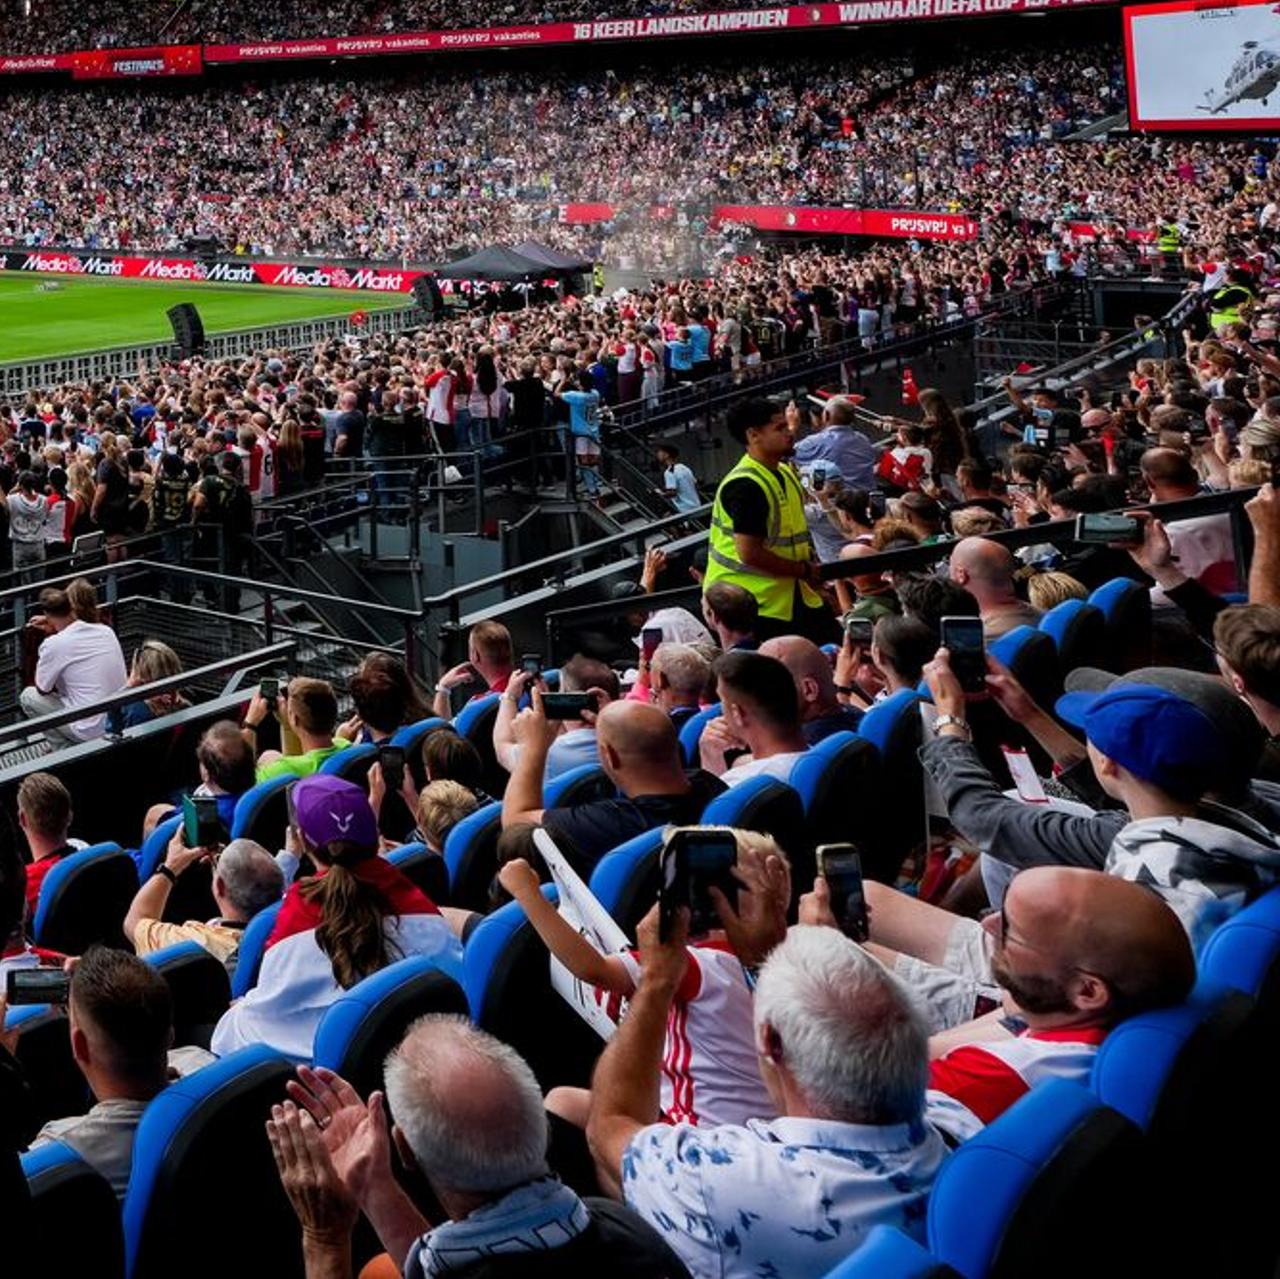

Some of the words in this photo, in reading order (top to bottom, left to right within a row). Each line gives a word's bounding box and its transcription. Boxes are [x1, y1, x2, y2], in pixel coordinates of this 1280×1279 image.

[574, 23, 590, 39] 16
[592, 20, 635, 38] KEER
[636, 8, 788, 36] LANDSKAMPIOEN
[385, 37, 431, 48] vakanties
[493, 30, 541, 42] vakanties
[286, 44, 327, 54] vakanties
[22, 255, 71, 272] Media
[81, 257, 124, 275] Markt
[142, 259, 190, 279] Media
[206, 262, 256, 282] Markt
[273, 265, 331, 286] Media
[346, 268, 404, 289] Markt
